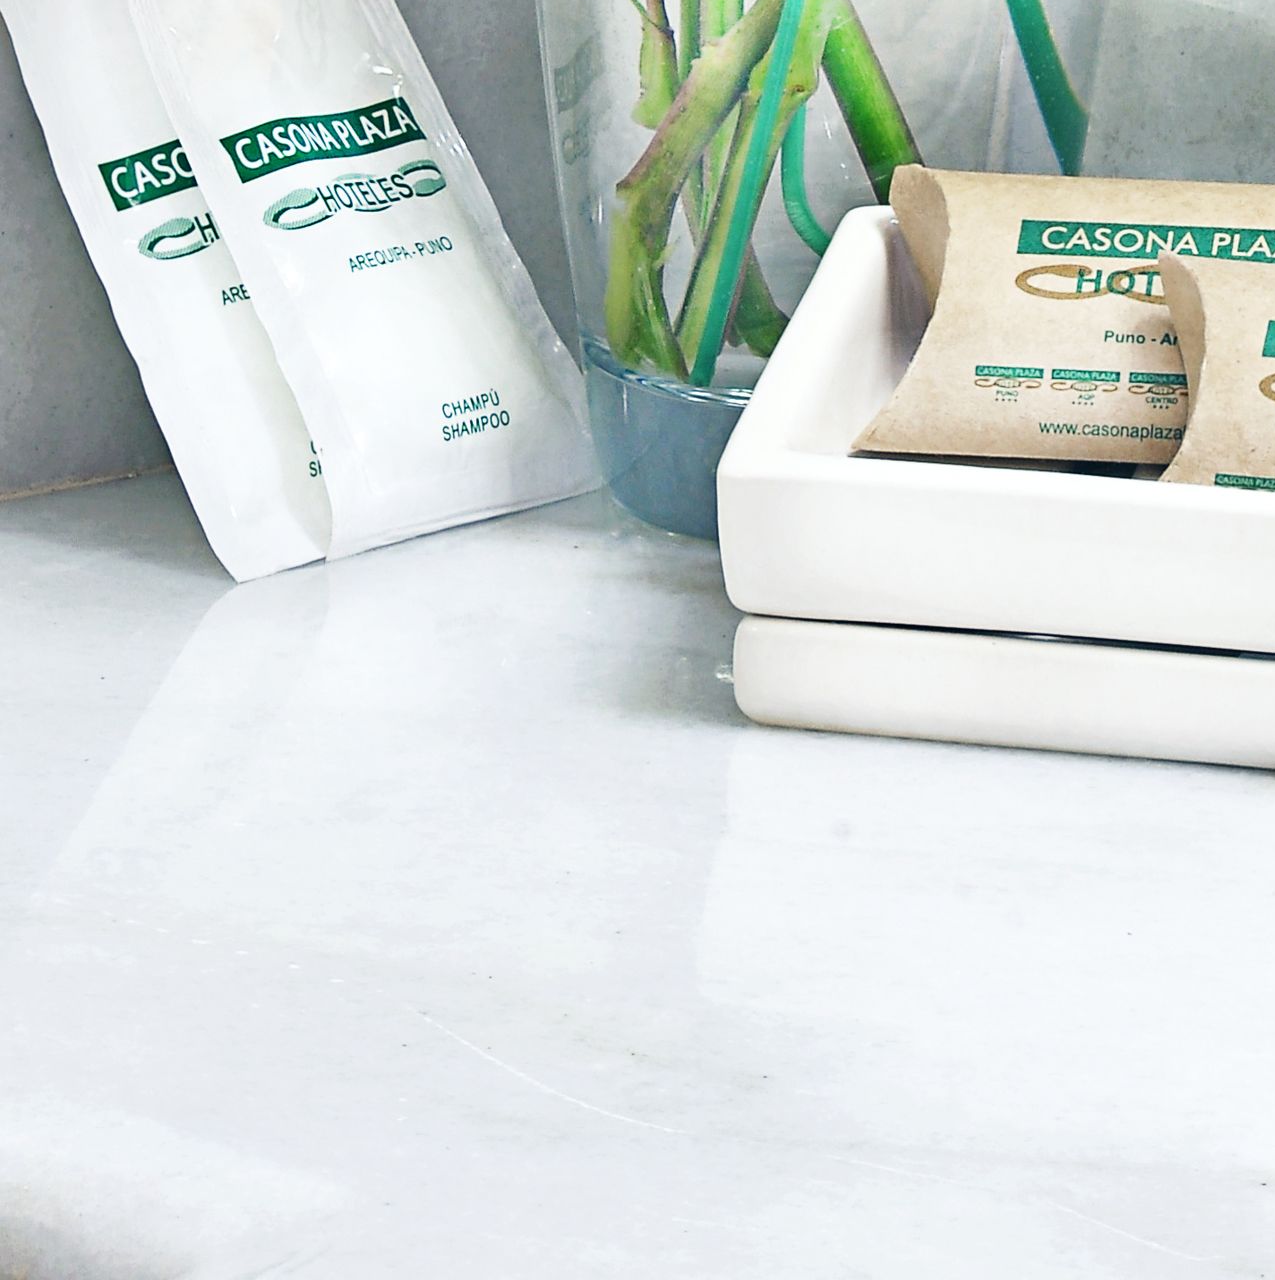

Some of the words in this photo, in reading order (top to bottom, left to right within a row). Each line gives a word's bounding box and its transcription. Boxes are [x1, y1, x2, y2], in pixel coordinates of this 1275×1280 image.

[234, 121, 335, 169] CASONA
[330, 105, 418, 150] PLAZA
[316, 173, 414, 213] HOTELES
[1041, 226, 1199, 255] CASONA
[1104, 330, 1146, 344] Puno
[976, 366, 1014, 377] CASONA
[1015, 369, 1042, 378] PLAZA
[1053, 370, 1090, 380] CASONA
[1092, 372, 1118, 382] PLAZA
[1131, 373, 1168, 383] CASONA
[1145, 396, 1179, 405] CENTRO
[442, 410, 511, 442] SHAMPOO
[1038, 422, 1187, 443] www.casonaplaza
[1215, 475, 1254, 487] CASONA
